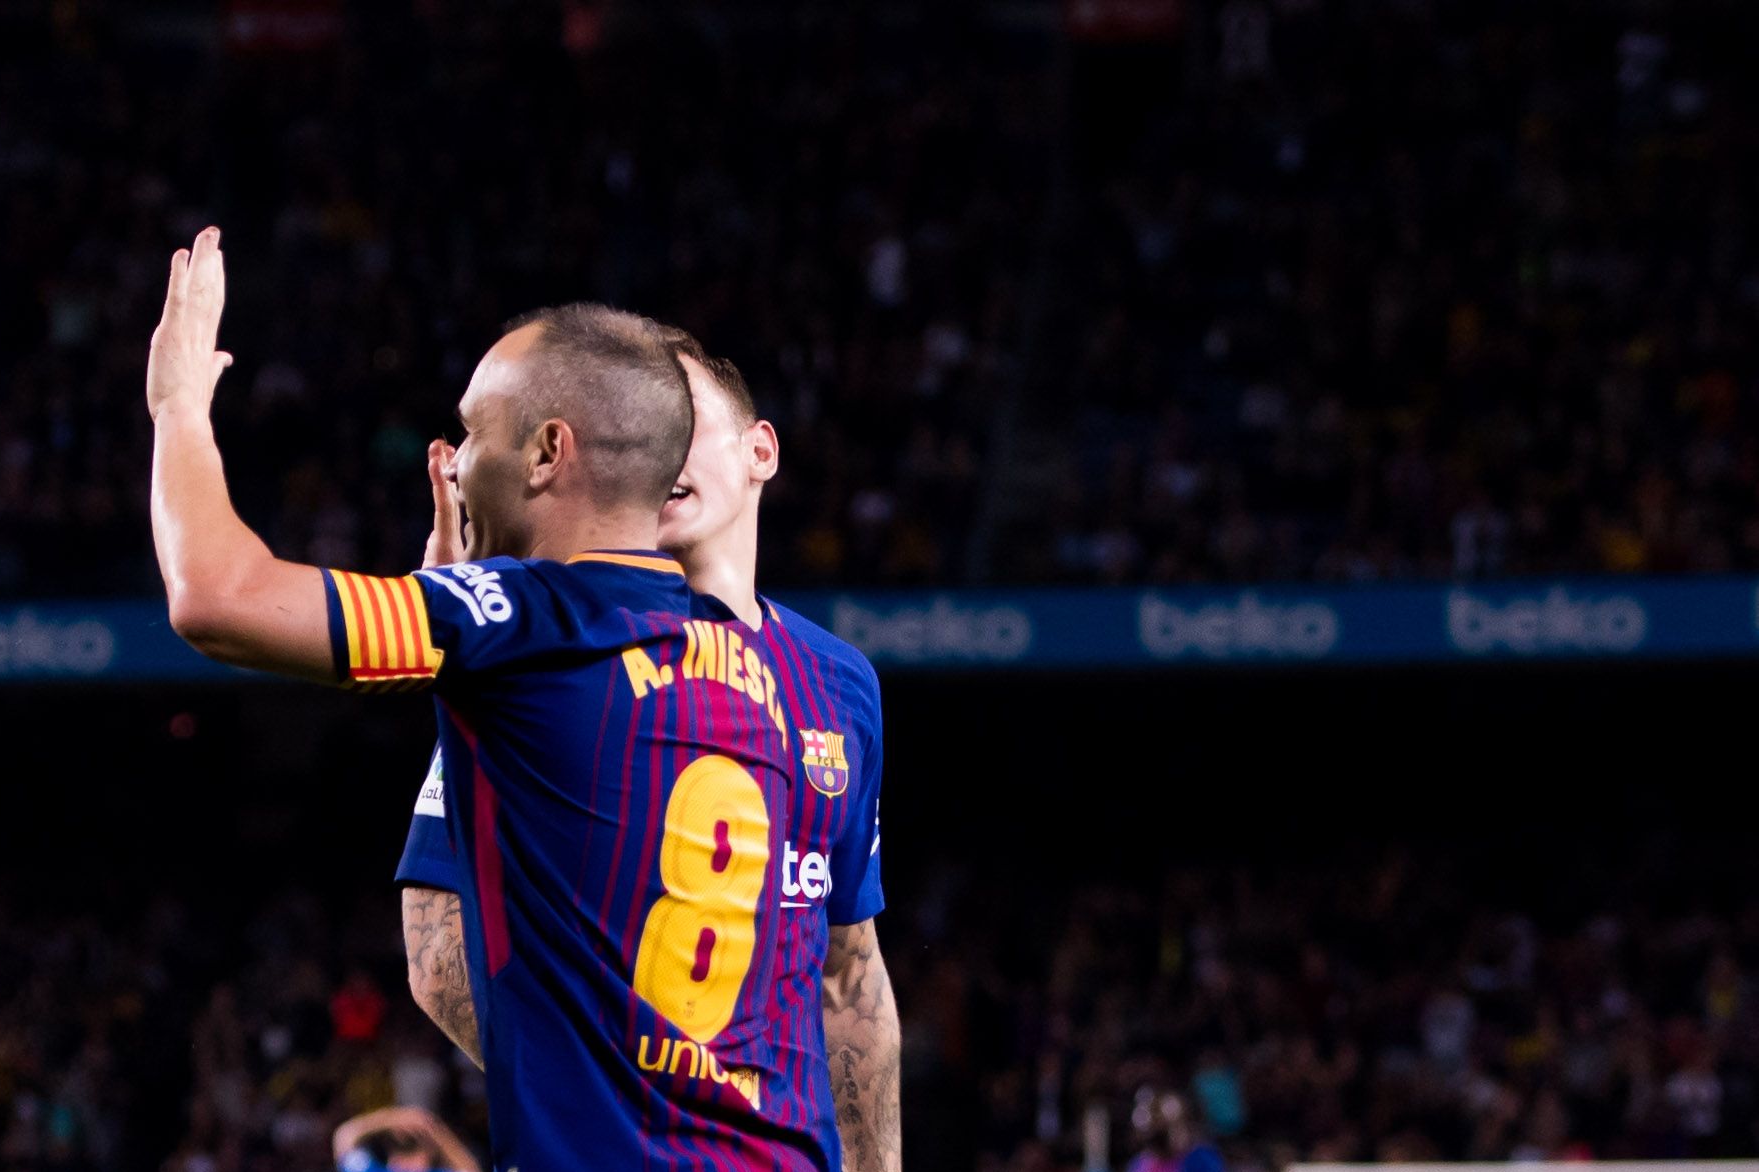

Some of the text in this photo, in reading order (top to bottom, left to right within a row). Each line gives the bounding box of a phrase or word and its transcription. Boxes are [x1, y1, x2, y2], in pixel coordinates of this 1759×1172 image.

[451, 562, 513, 623] eko
[1139, 590, 1337, 658] beko
[1447, 585, 1645, 655] beko
[632, 754, 770, 1044] 8
[781, 840, 833, 899] te
[637, 1035, 741, 1090] unic
